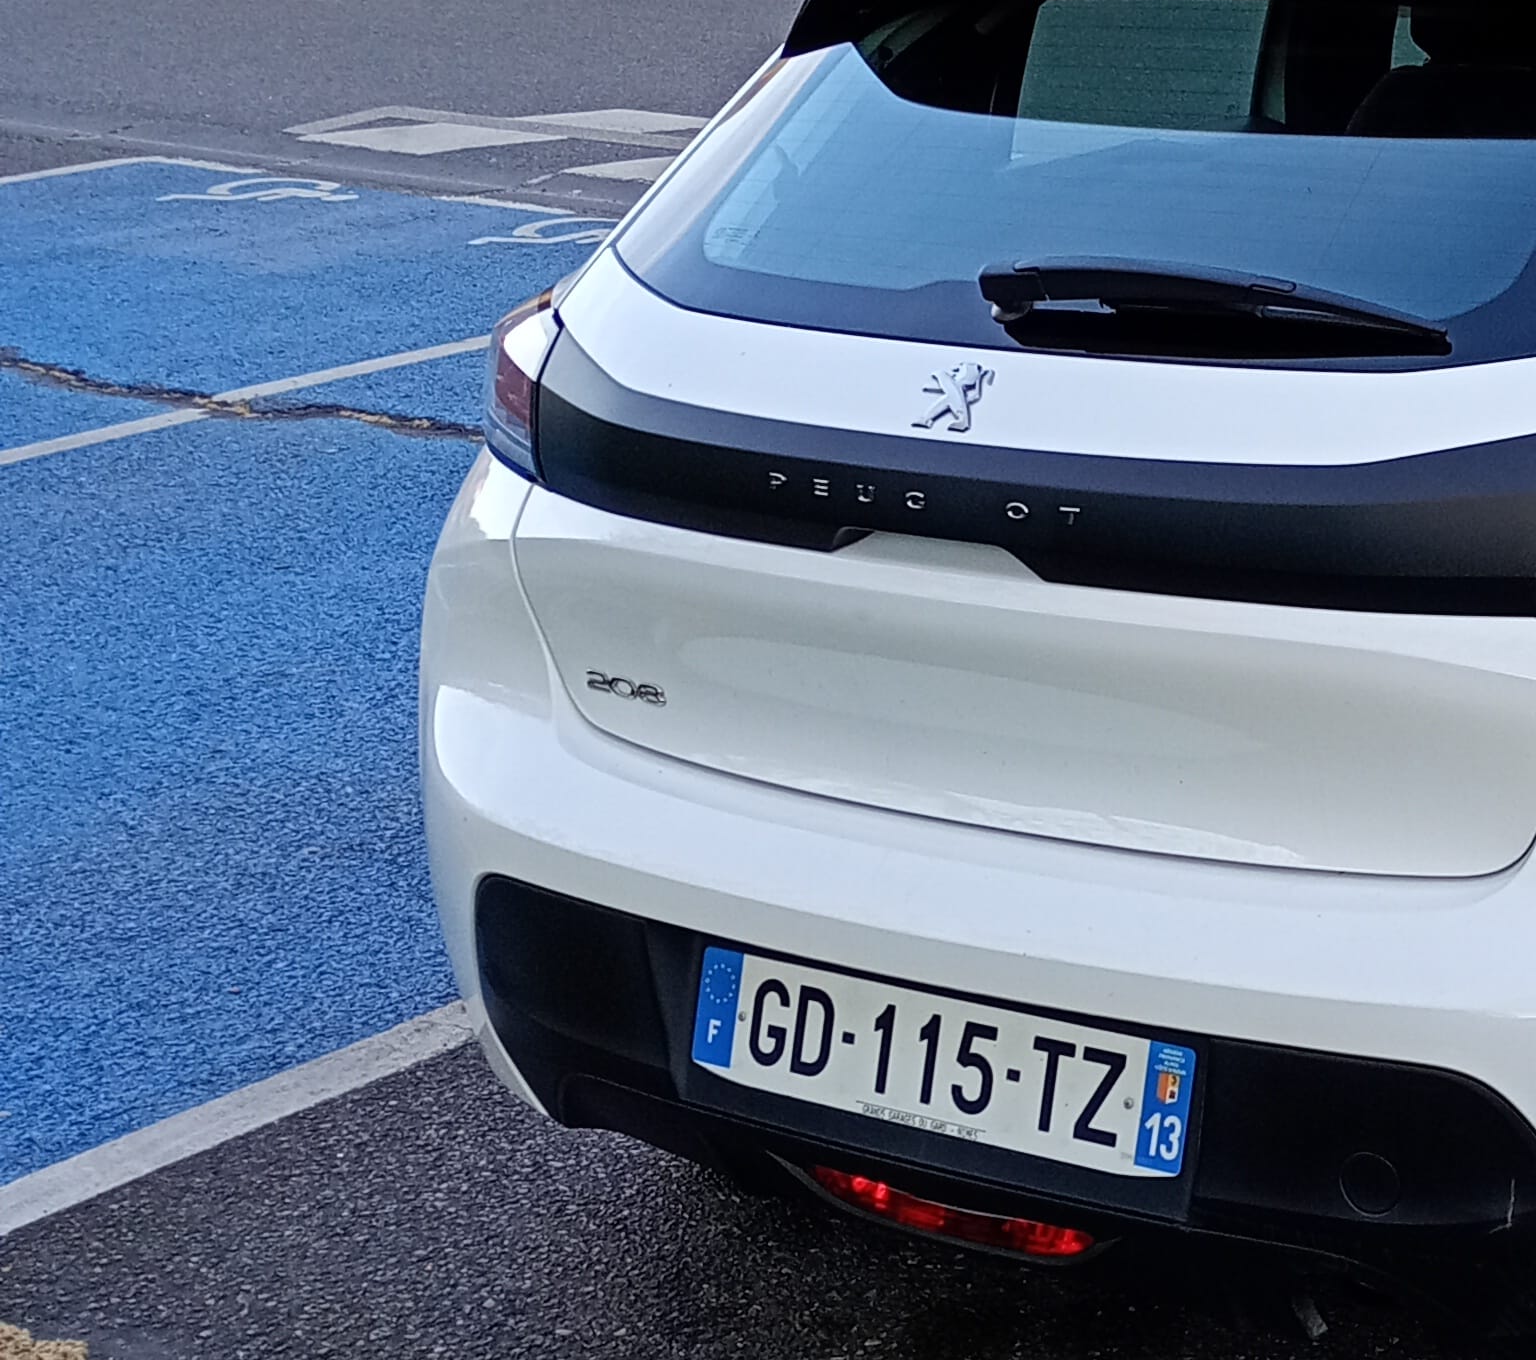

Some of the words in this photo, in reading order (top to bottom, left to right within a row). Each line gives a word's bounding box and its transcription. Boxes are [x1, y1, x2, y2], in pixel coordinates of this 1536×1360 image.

[768, 471, 1081, 526] PEUGOT
[585, 667, 669, 708] 208
[706, 1018, 722, 1045] F
[747, 977, 1128, 1149] GD-115-TZ
[1143, 1111, 1183, 1161] 13
